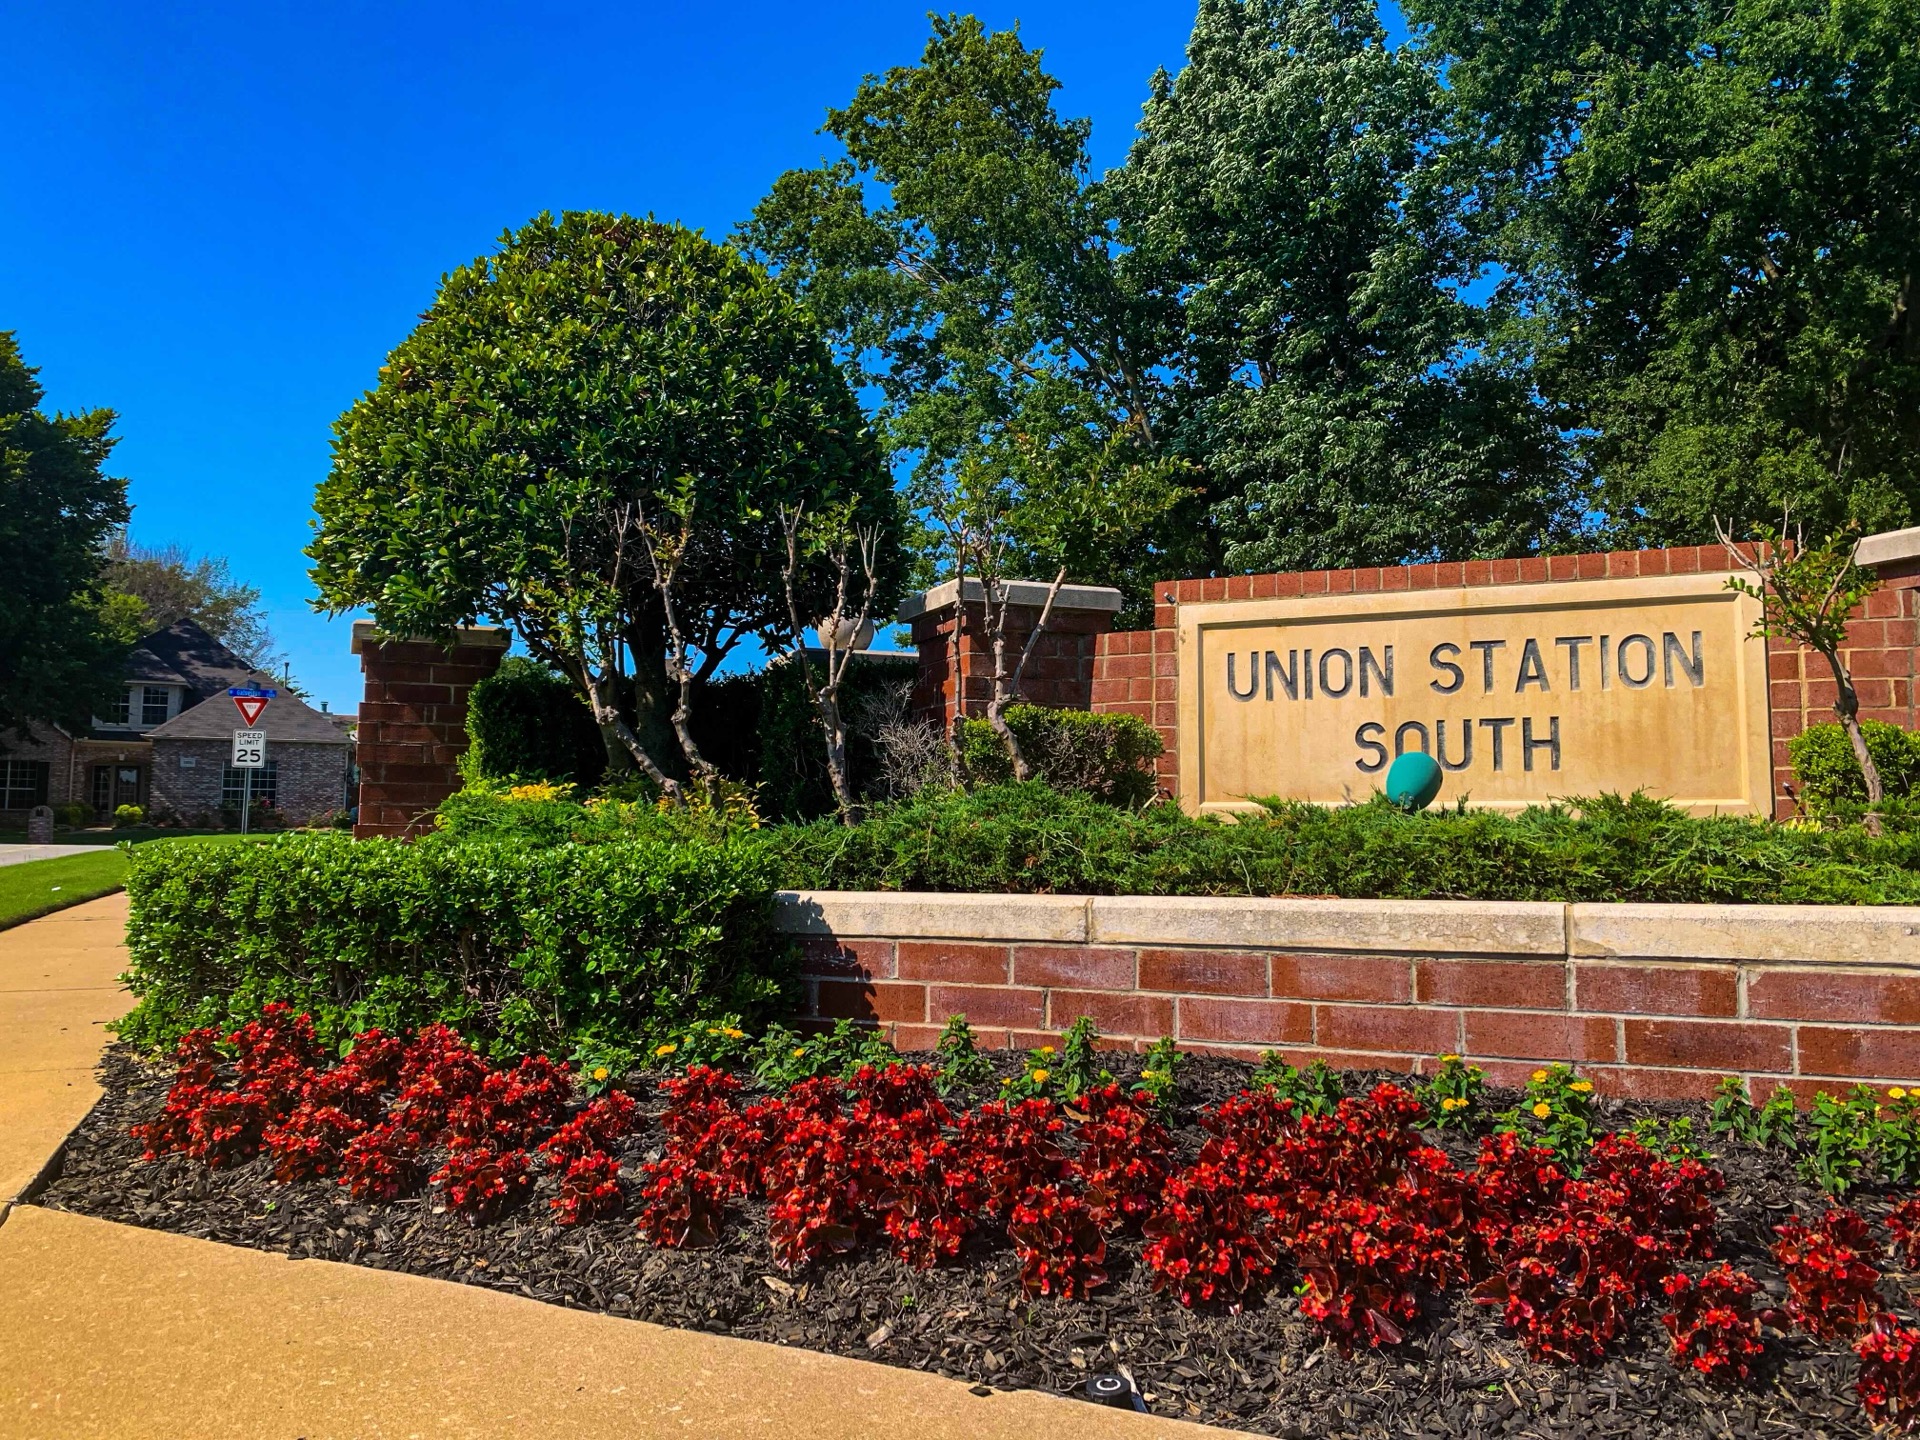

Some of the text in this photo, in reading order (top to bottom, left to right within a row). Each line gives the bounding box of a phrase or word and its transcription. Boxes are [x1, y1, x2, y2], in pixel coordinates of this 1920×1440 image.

[1227, 630, 1705, 702] UNION STATION
[236, 749, 261, 763] 25
[1355, 716, 1562, 774] SOUTH
